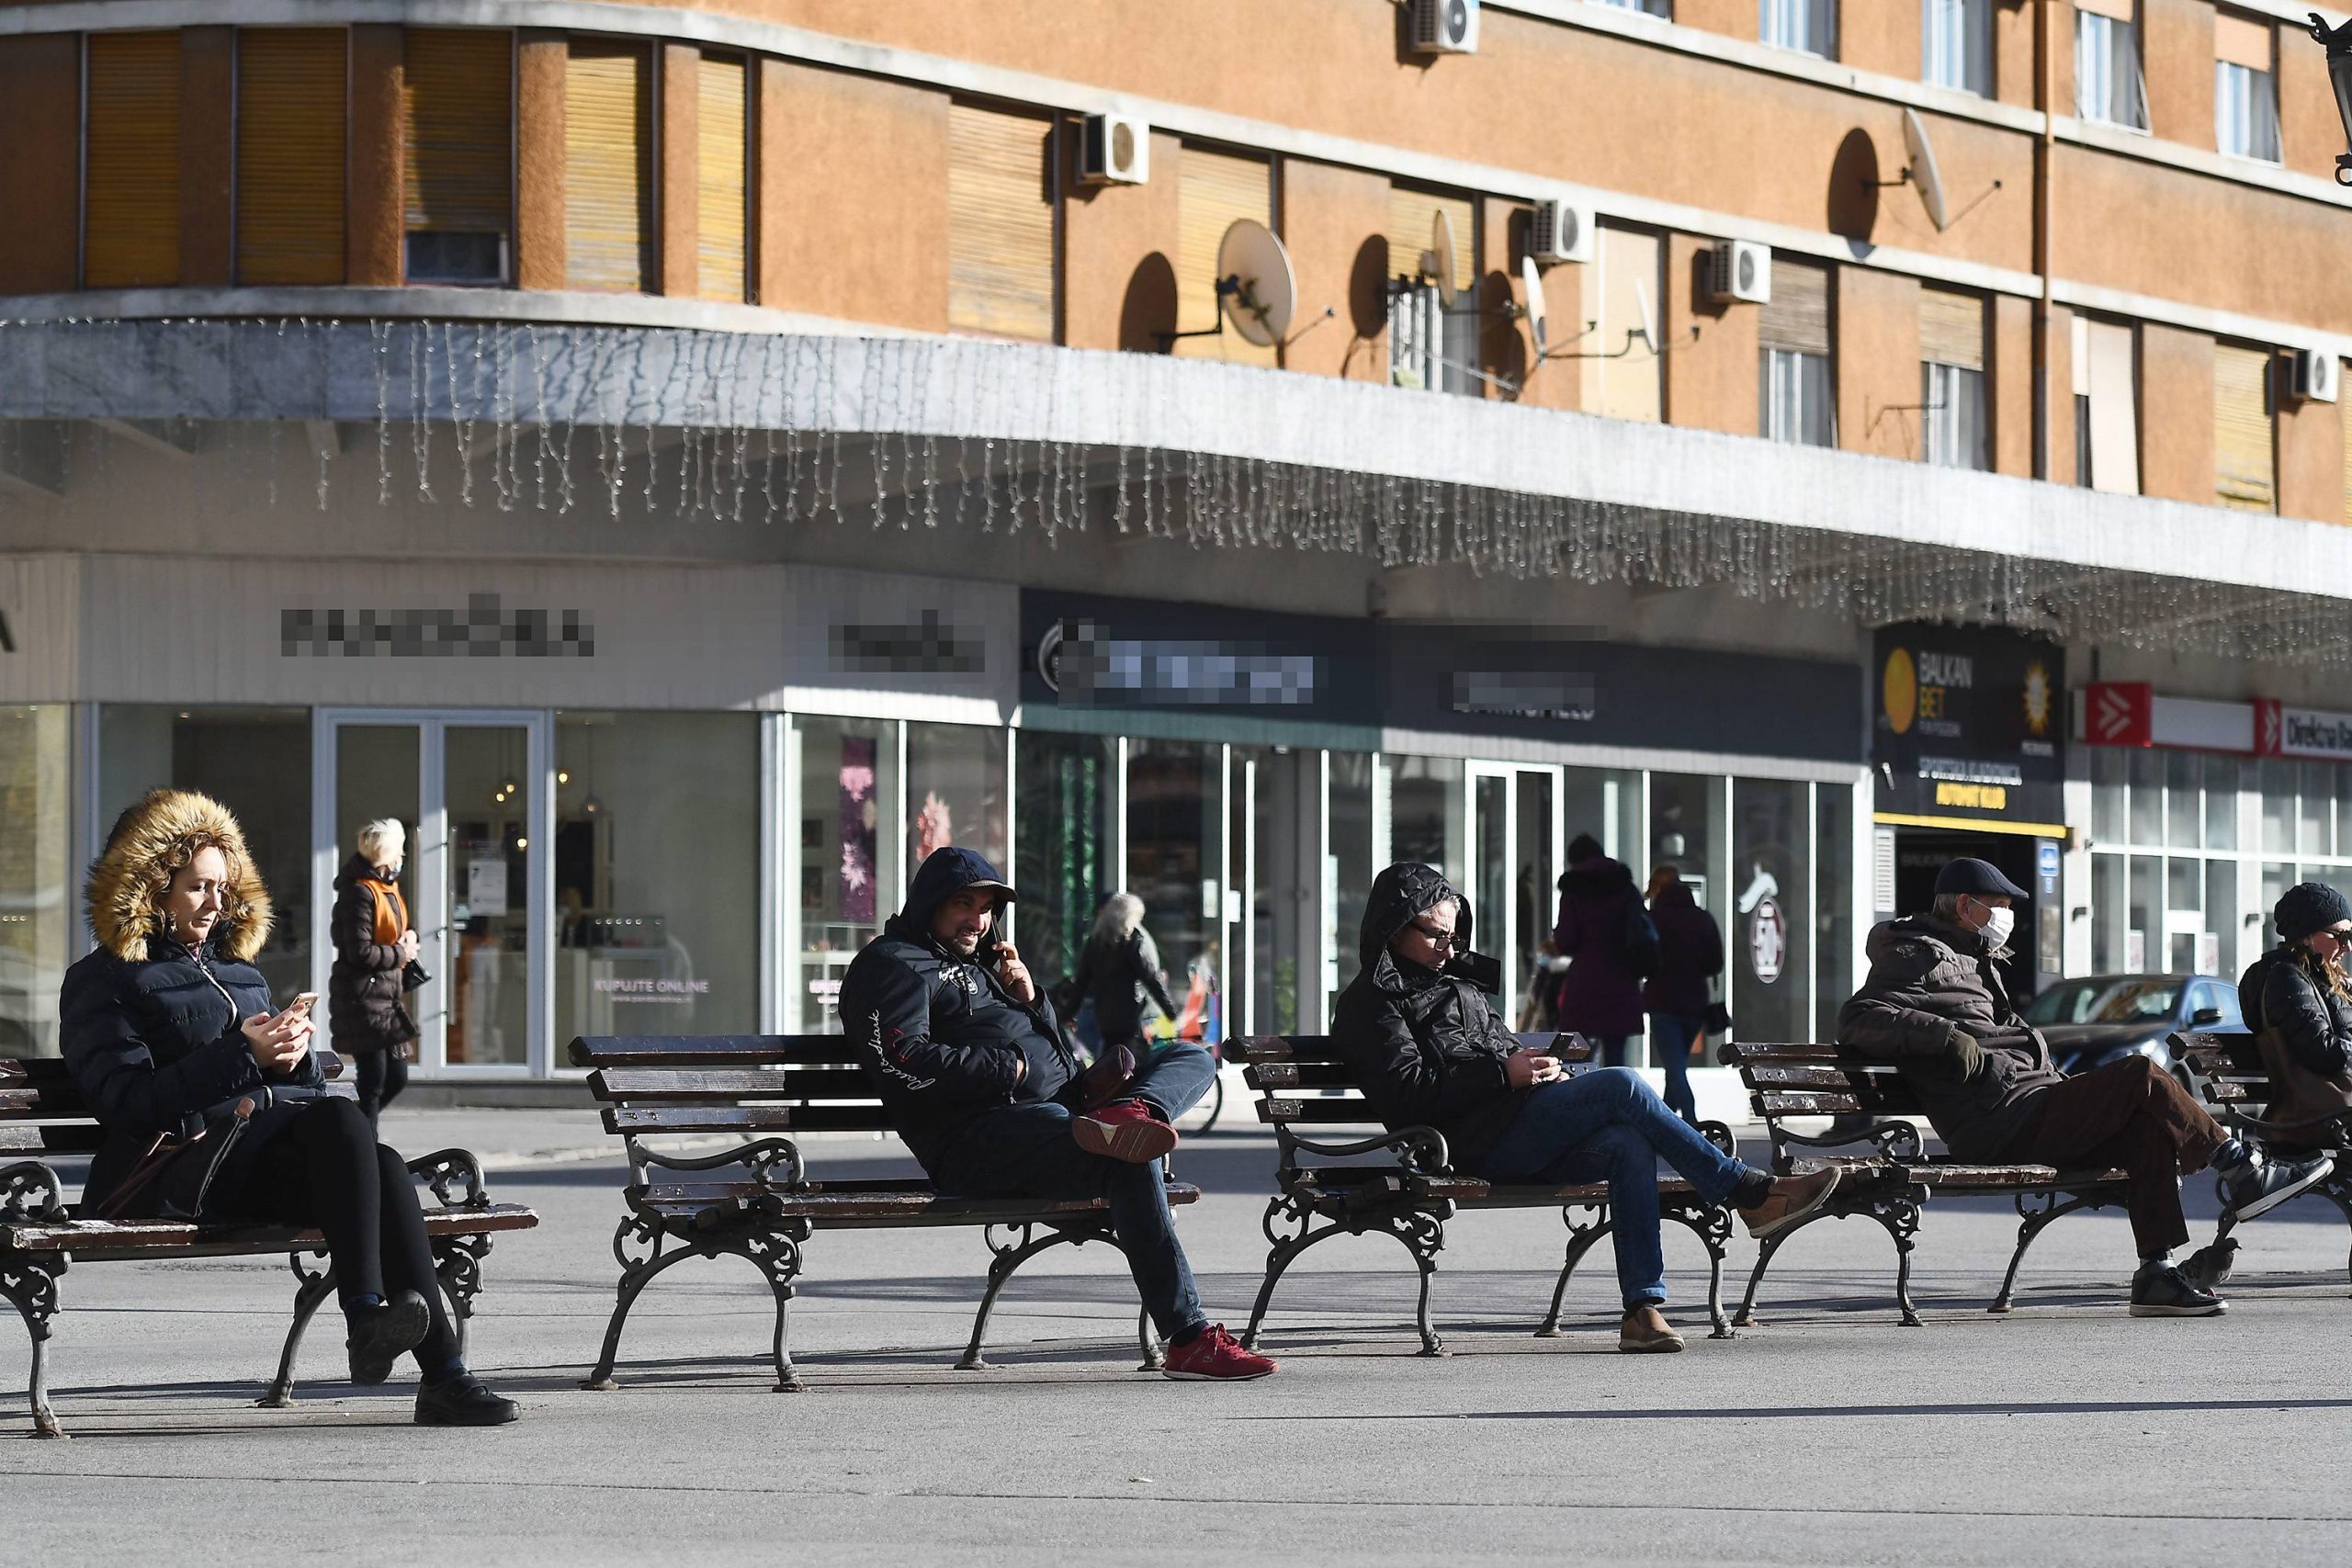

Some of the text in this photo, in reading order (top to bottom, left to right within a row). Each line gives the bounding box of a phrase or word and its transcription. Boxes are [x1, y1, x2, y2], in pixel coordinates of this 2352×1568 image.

[1919, 651, 1973, 689] BALKAN
[1919, 686, 1946, 718] BET
[594, 978, 709, 993] KUPUJTE ONLINE
